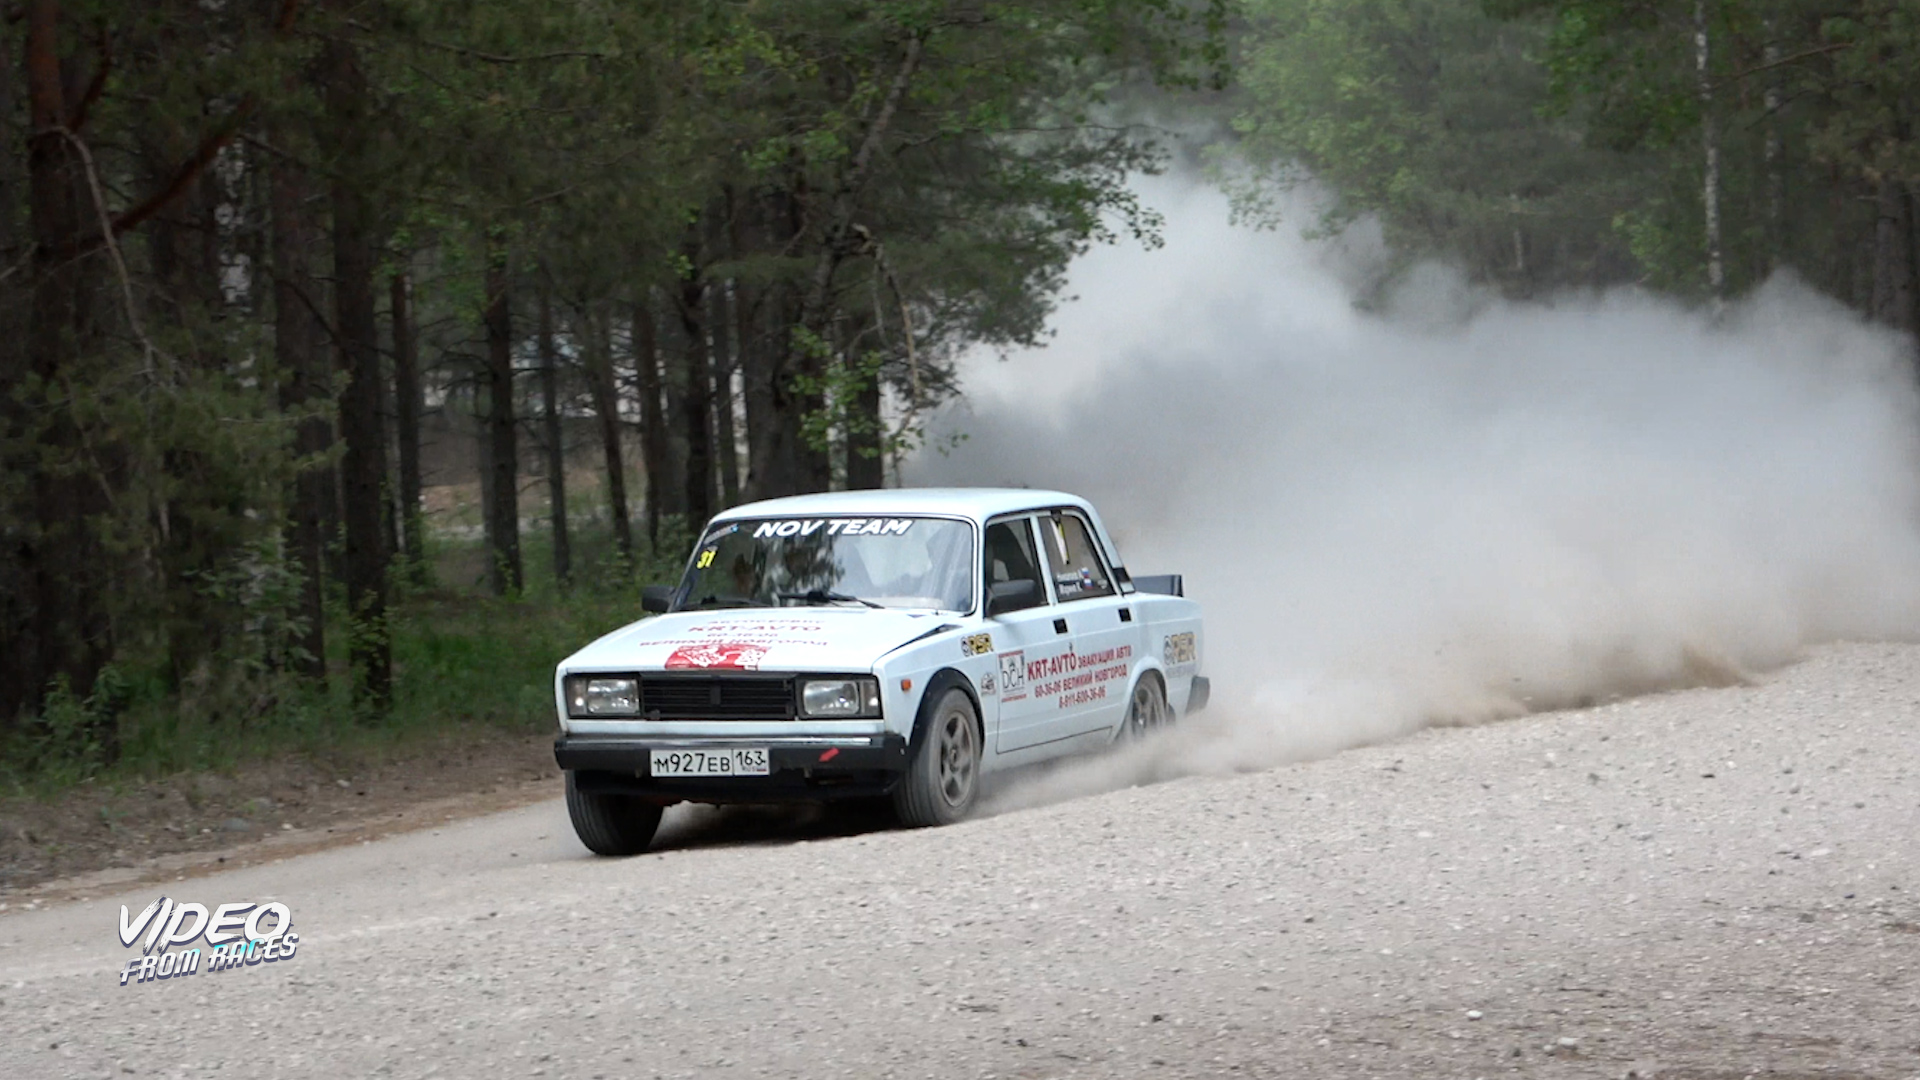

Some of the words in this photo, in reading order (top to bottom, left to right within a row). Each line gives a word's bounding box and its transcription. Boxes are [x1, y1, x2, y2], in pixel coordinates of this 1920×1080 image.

[753, 520, 824, 539] NOV
[827, 519, 914, 536] TEAM
[696, 550, 717, 569] 31
[1027, 652, 1077, 681] KRT-AVTO
[1063, 669, 1093, 691] ВЕЛИКИЙ
[1095, 664, 1128, 682] НОВГОРОД
[735, 751, 764, 766] 163
